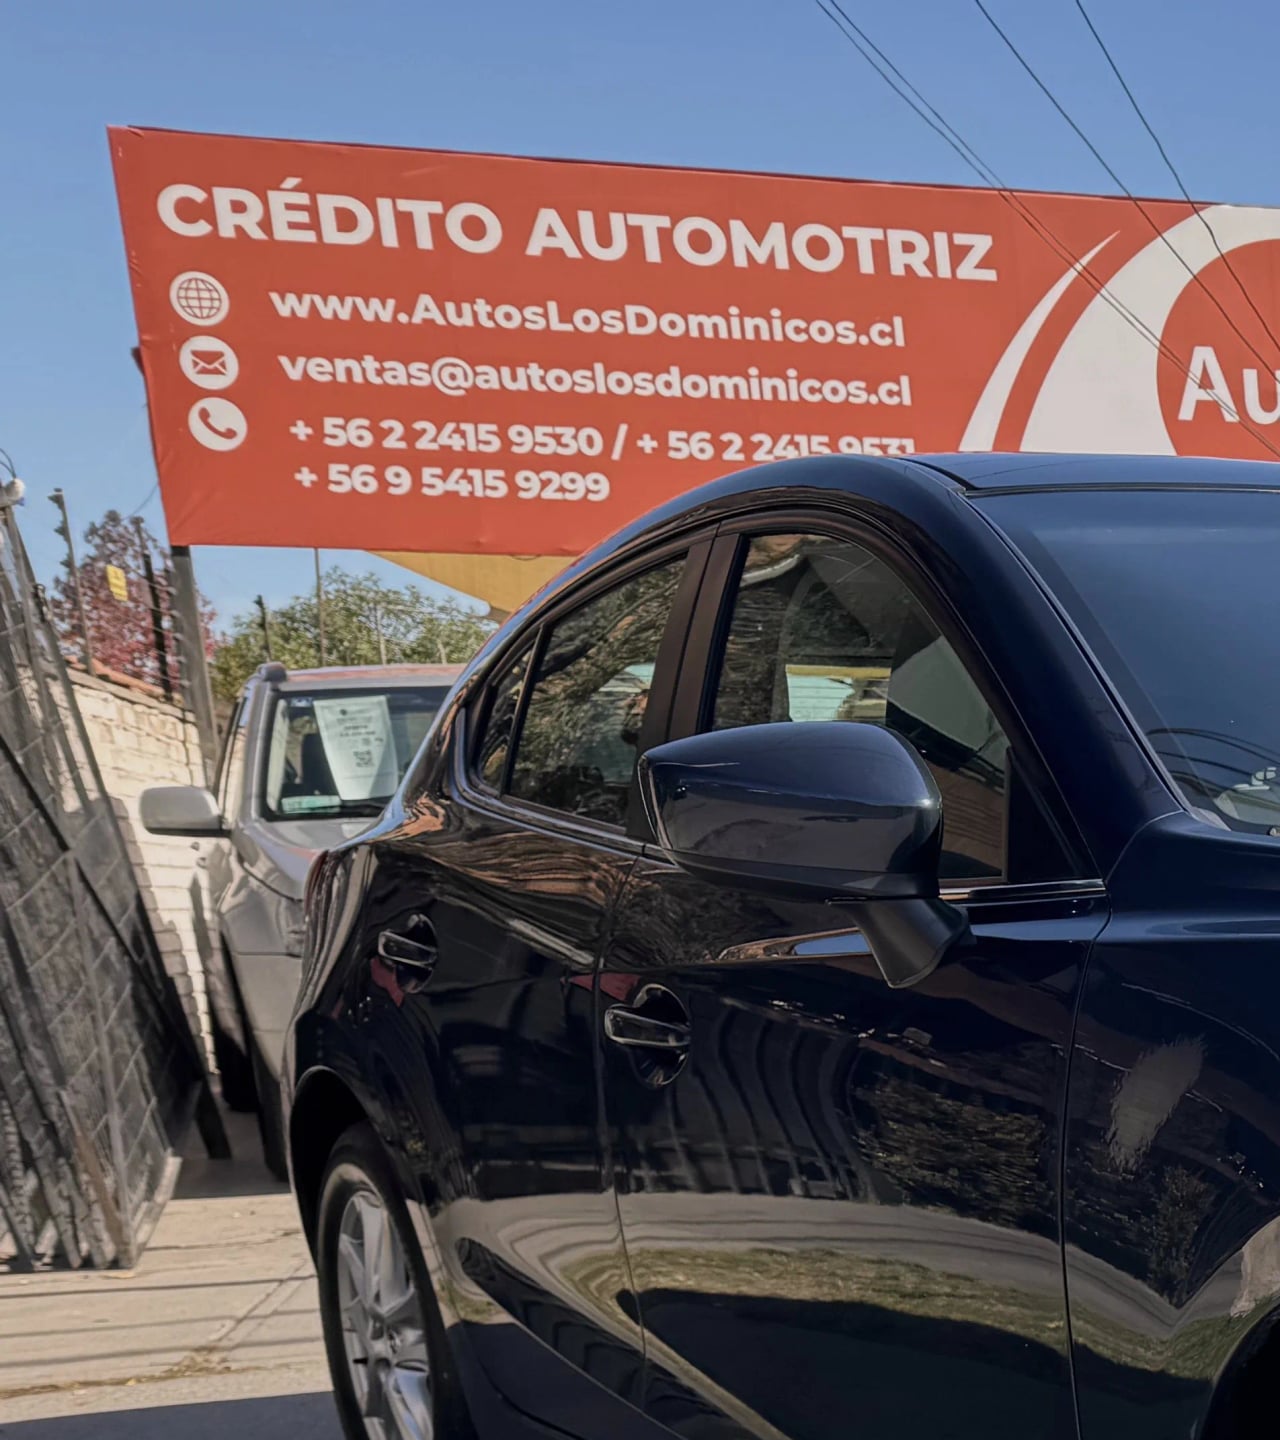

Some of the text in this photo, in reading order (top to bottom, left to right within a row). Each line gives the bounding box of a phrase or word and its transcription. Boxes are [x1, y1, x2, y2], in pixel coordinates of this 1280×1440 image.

[157, 177, 998, 282] CRÉDITO AUTOMOTRIZ
[269, 292, 905, 347] www.AutosLosDominicos.cl
[278, 355, 912, 407] ventas@autoslosdominicos.cl
[323, 417, 374, 448] 56
[379, 418, 407, 449] 2
[413, 420, 502, 453] 2415
[507, 424, 604, 457] 9530
[668, 430, 715, 461] 56
[719, 432, 745, 462] 2
[328, 463, 379, 495] 56
[384, 465, 412, 495] 9
[421, 467, 509, 498] 5415
[515, 470, 610, 502] 9299
